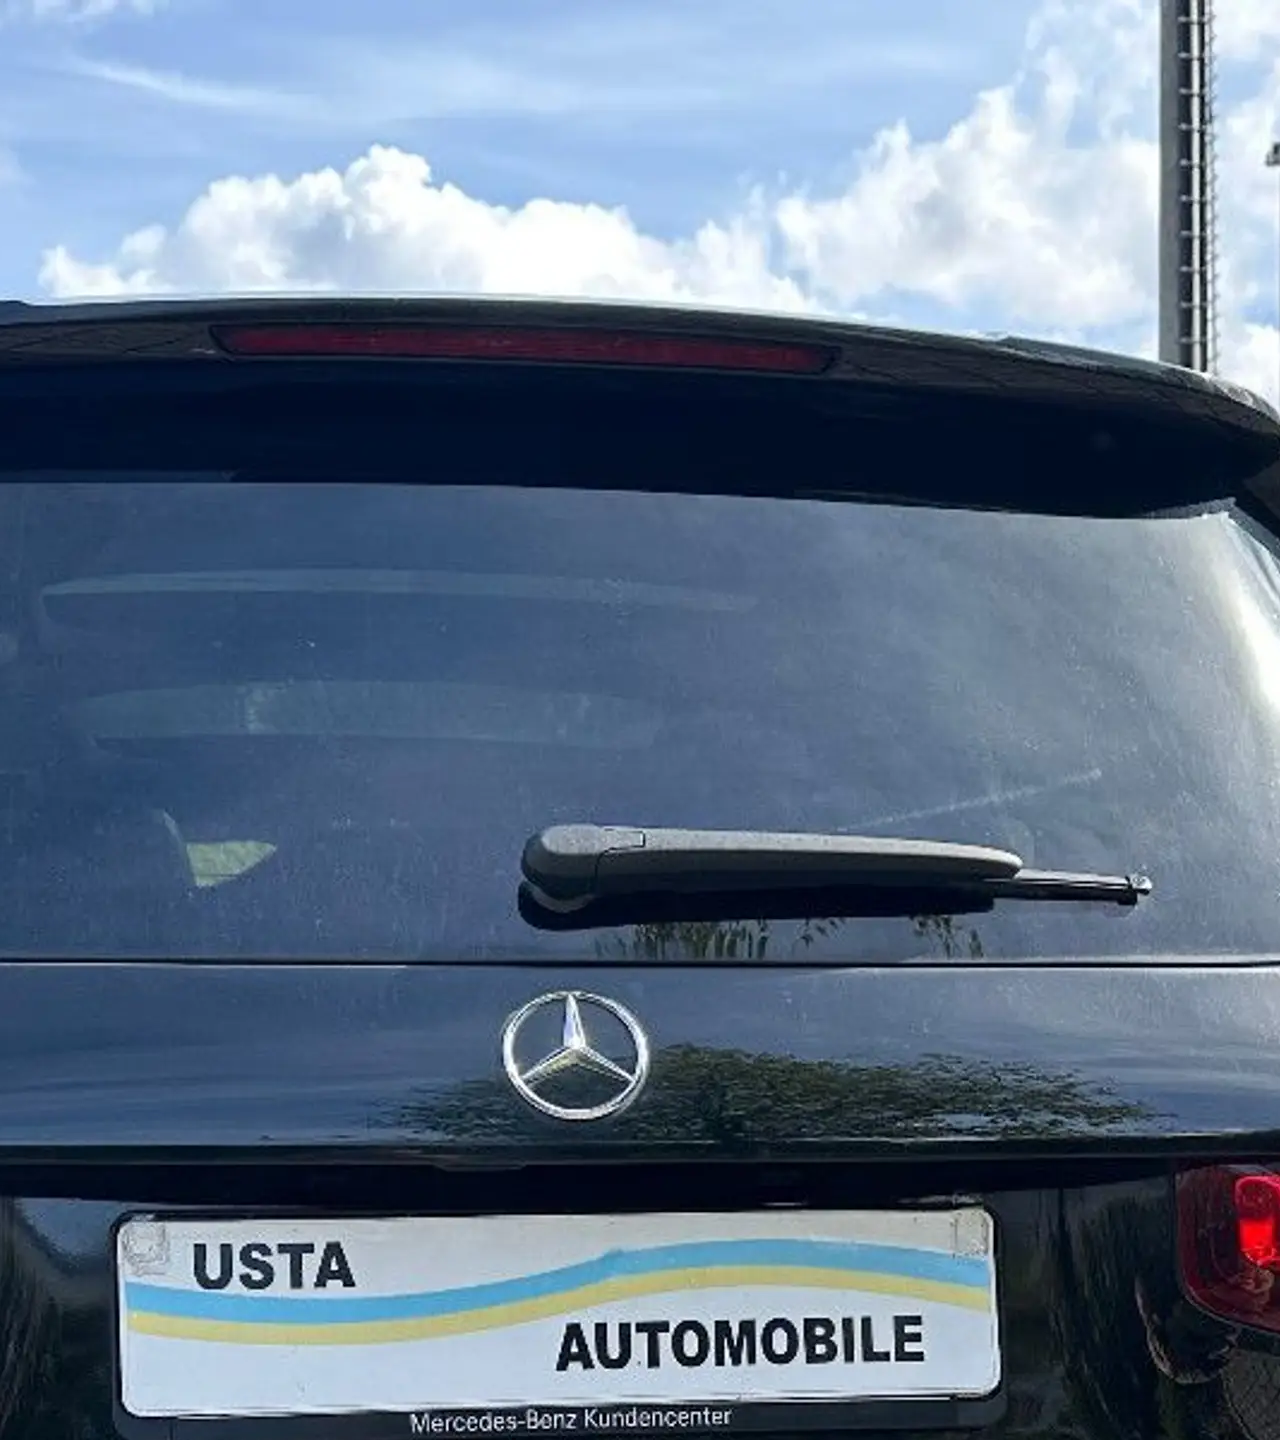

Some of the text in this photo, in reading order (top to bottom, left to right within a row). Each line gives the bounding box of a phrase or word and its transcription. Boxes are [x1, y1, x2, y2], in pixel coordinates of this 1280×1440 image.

[193, 1241, 356, 1290] USTA
[556, 1315, 925, 1371] AUTOMOBILE
[409, 1407, 733, 1433] Mercedes-Benz Kundencenter
